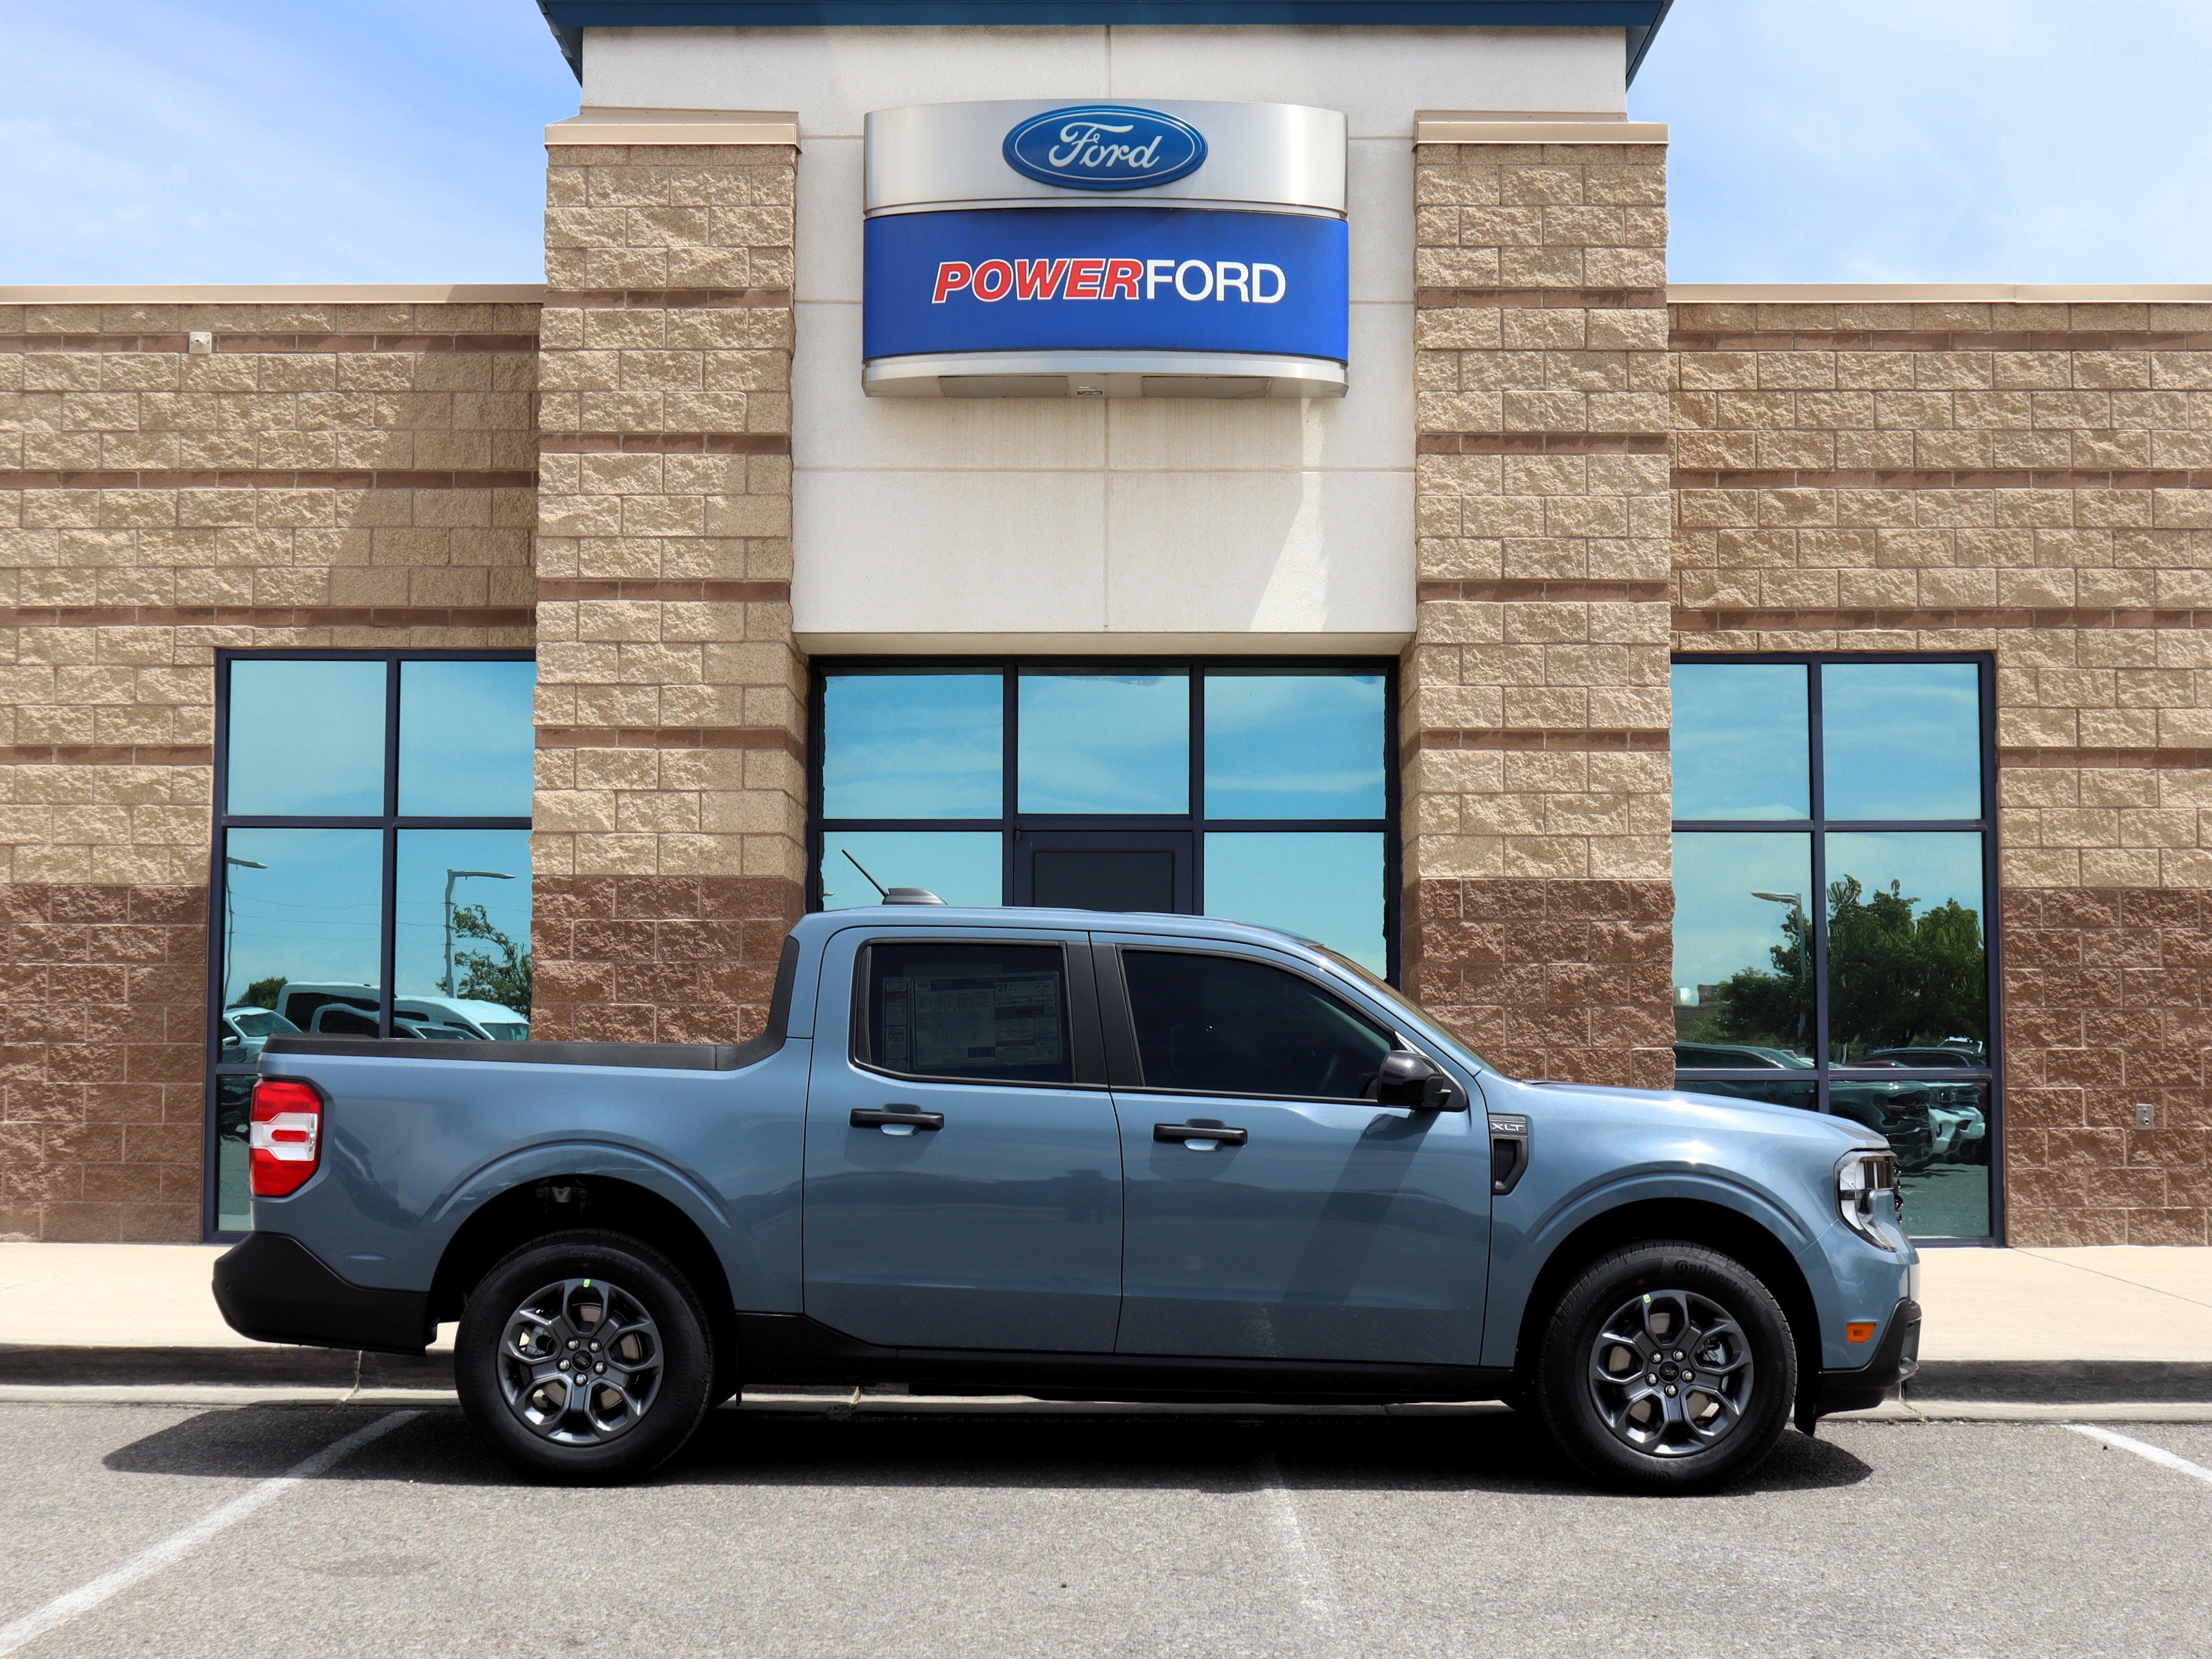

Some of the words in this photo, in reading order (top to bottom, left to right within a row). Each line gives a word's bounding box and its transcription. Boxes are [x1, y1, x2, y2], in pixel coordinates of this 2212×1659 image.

[1048, 121, 1163, 168] Ford
[1491, 1123, 1525, 1132] XLT
[1674, 1260, 1749, 1298] Continental
